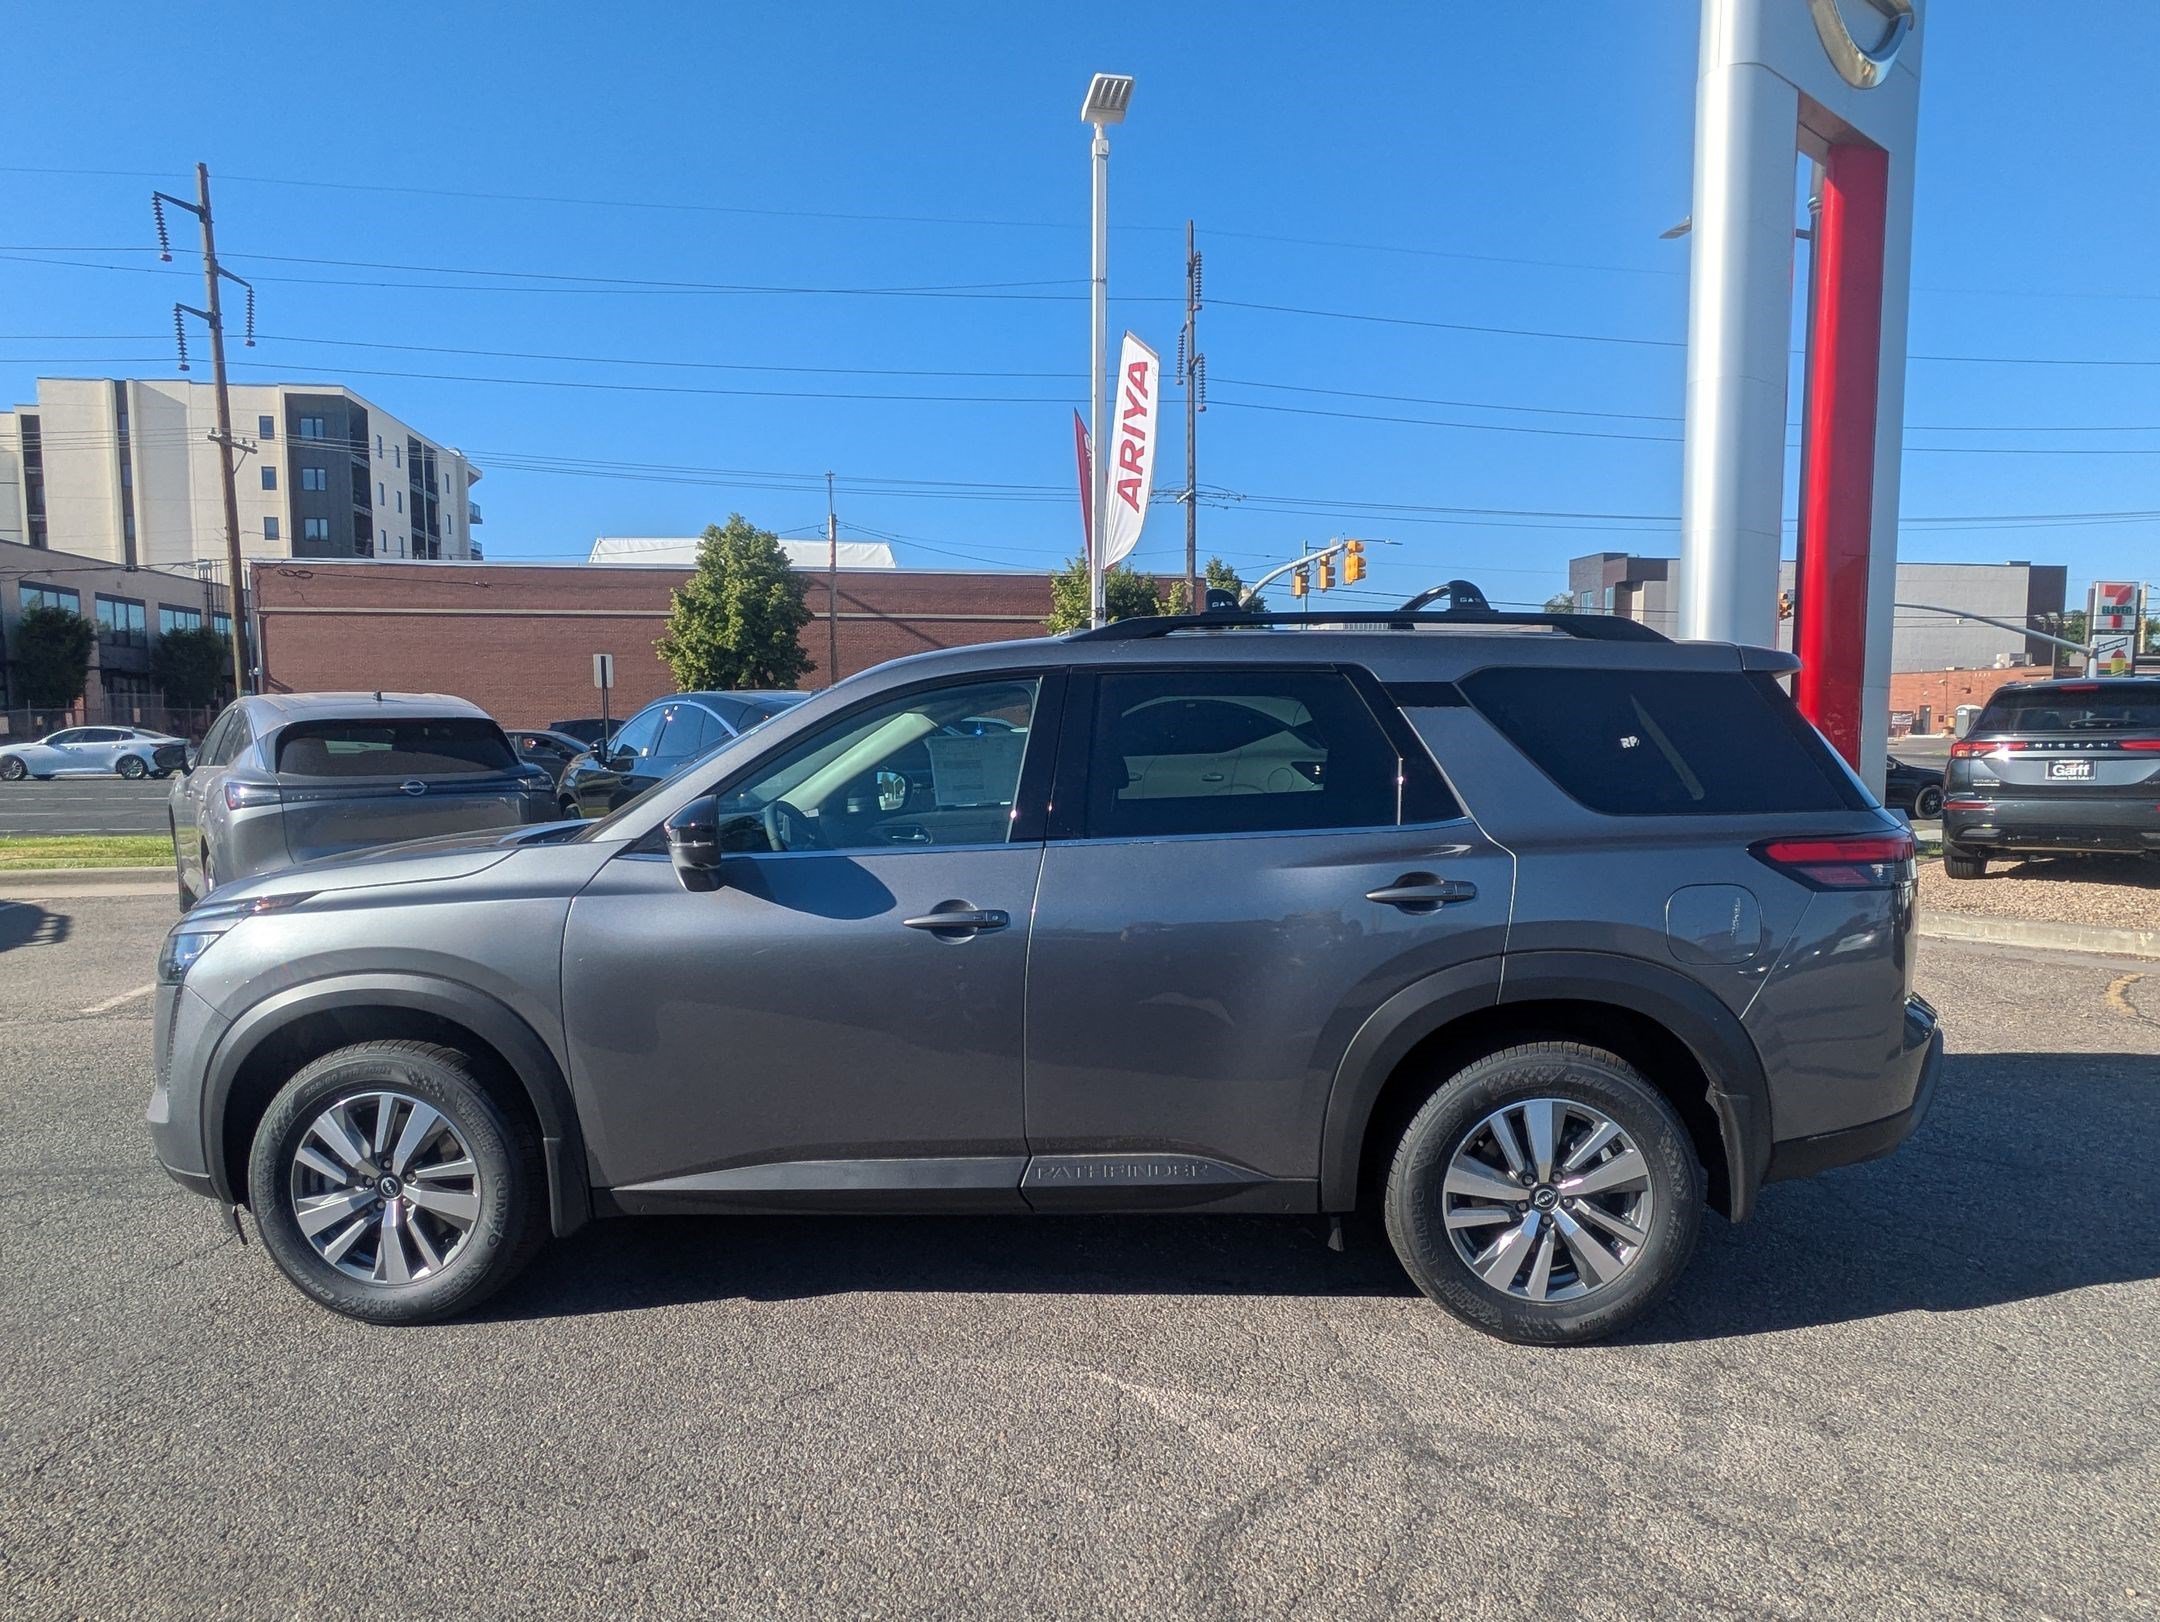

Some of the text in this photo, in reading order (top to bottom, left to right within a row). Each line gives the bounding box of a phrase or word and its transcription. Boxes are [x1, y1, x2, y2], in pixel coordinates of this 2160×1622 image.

[1117, 361, 1149, 513] ARIYA
[2103, 584, 2132, 628] 7
[2034, 740, 2109, 749] NISSAN
[2052, 763, 2091, 777] Garff
[1037, 1160, 1208, 1179] PATHFINDER
[488, 1173, 507, 1248] KUMHO
